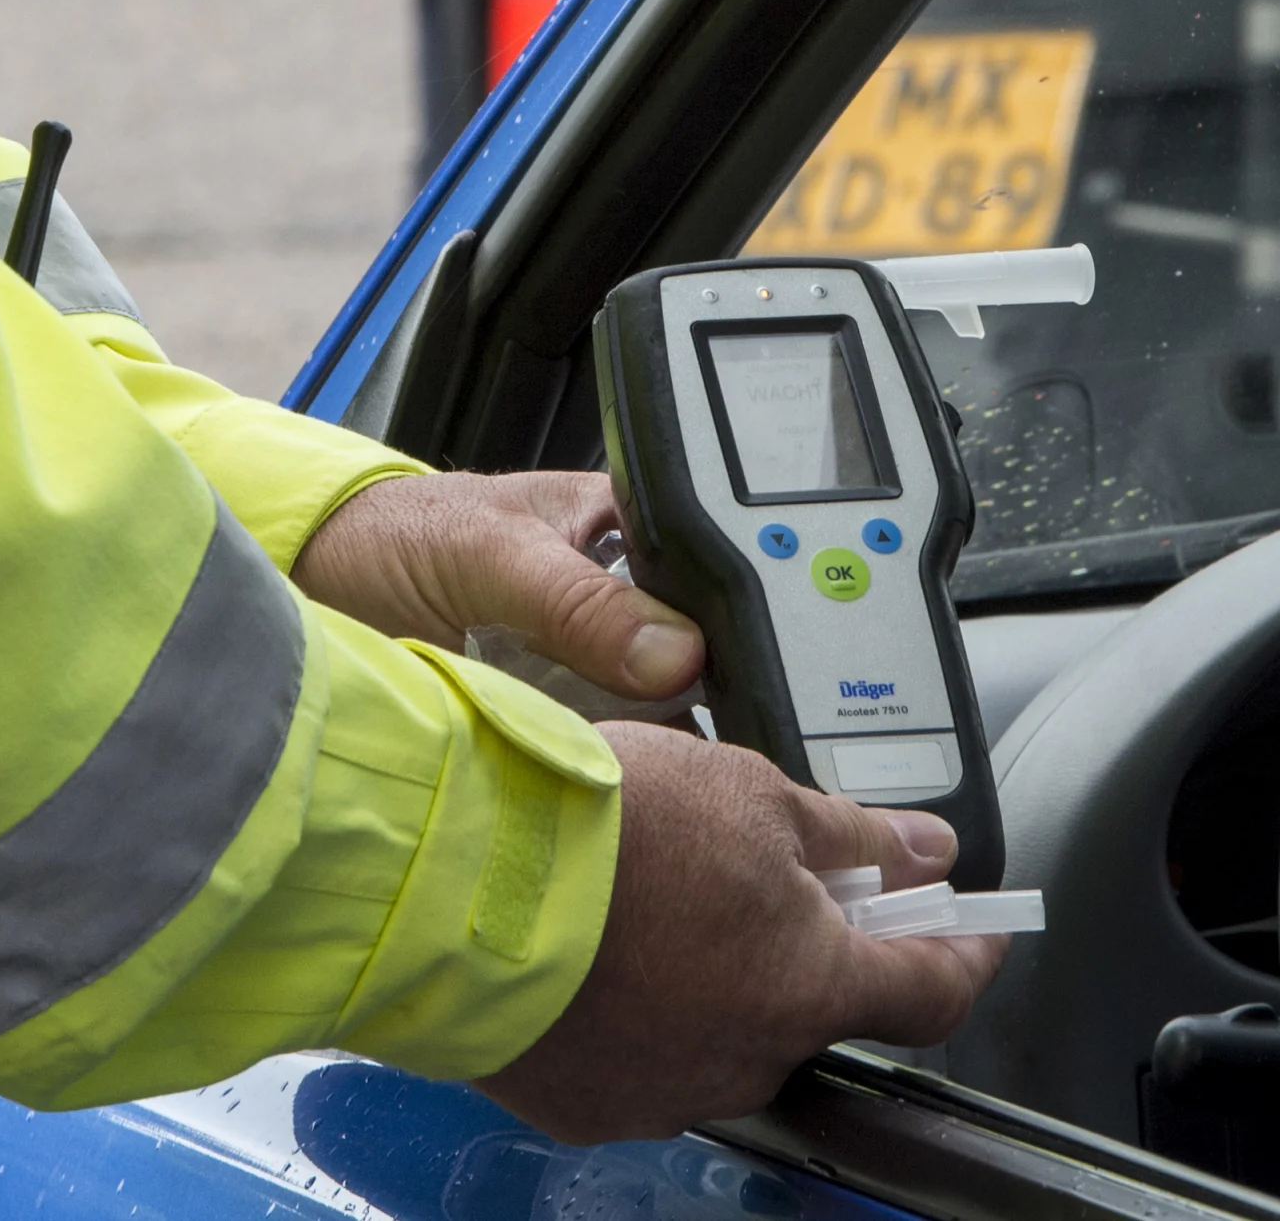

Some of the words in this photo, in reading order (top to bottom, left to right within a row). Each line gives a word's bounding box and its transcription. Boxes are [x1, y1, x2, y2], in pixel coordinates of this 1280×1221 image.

[825, 565, 855, 581] OK
[838, 680, 895, 700] Dräger
[837, 707, 880, 718] Alcotest
[881, 705, 909, 715] 7510
